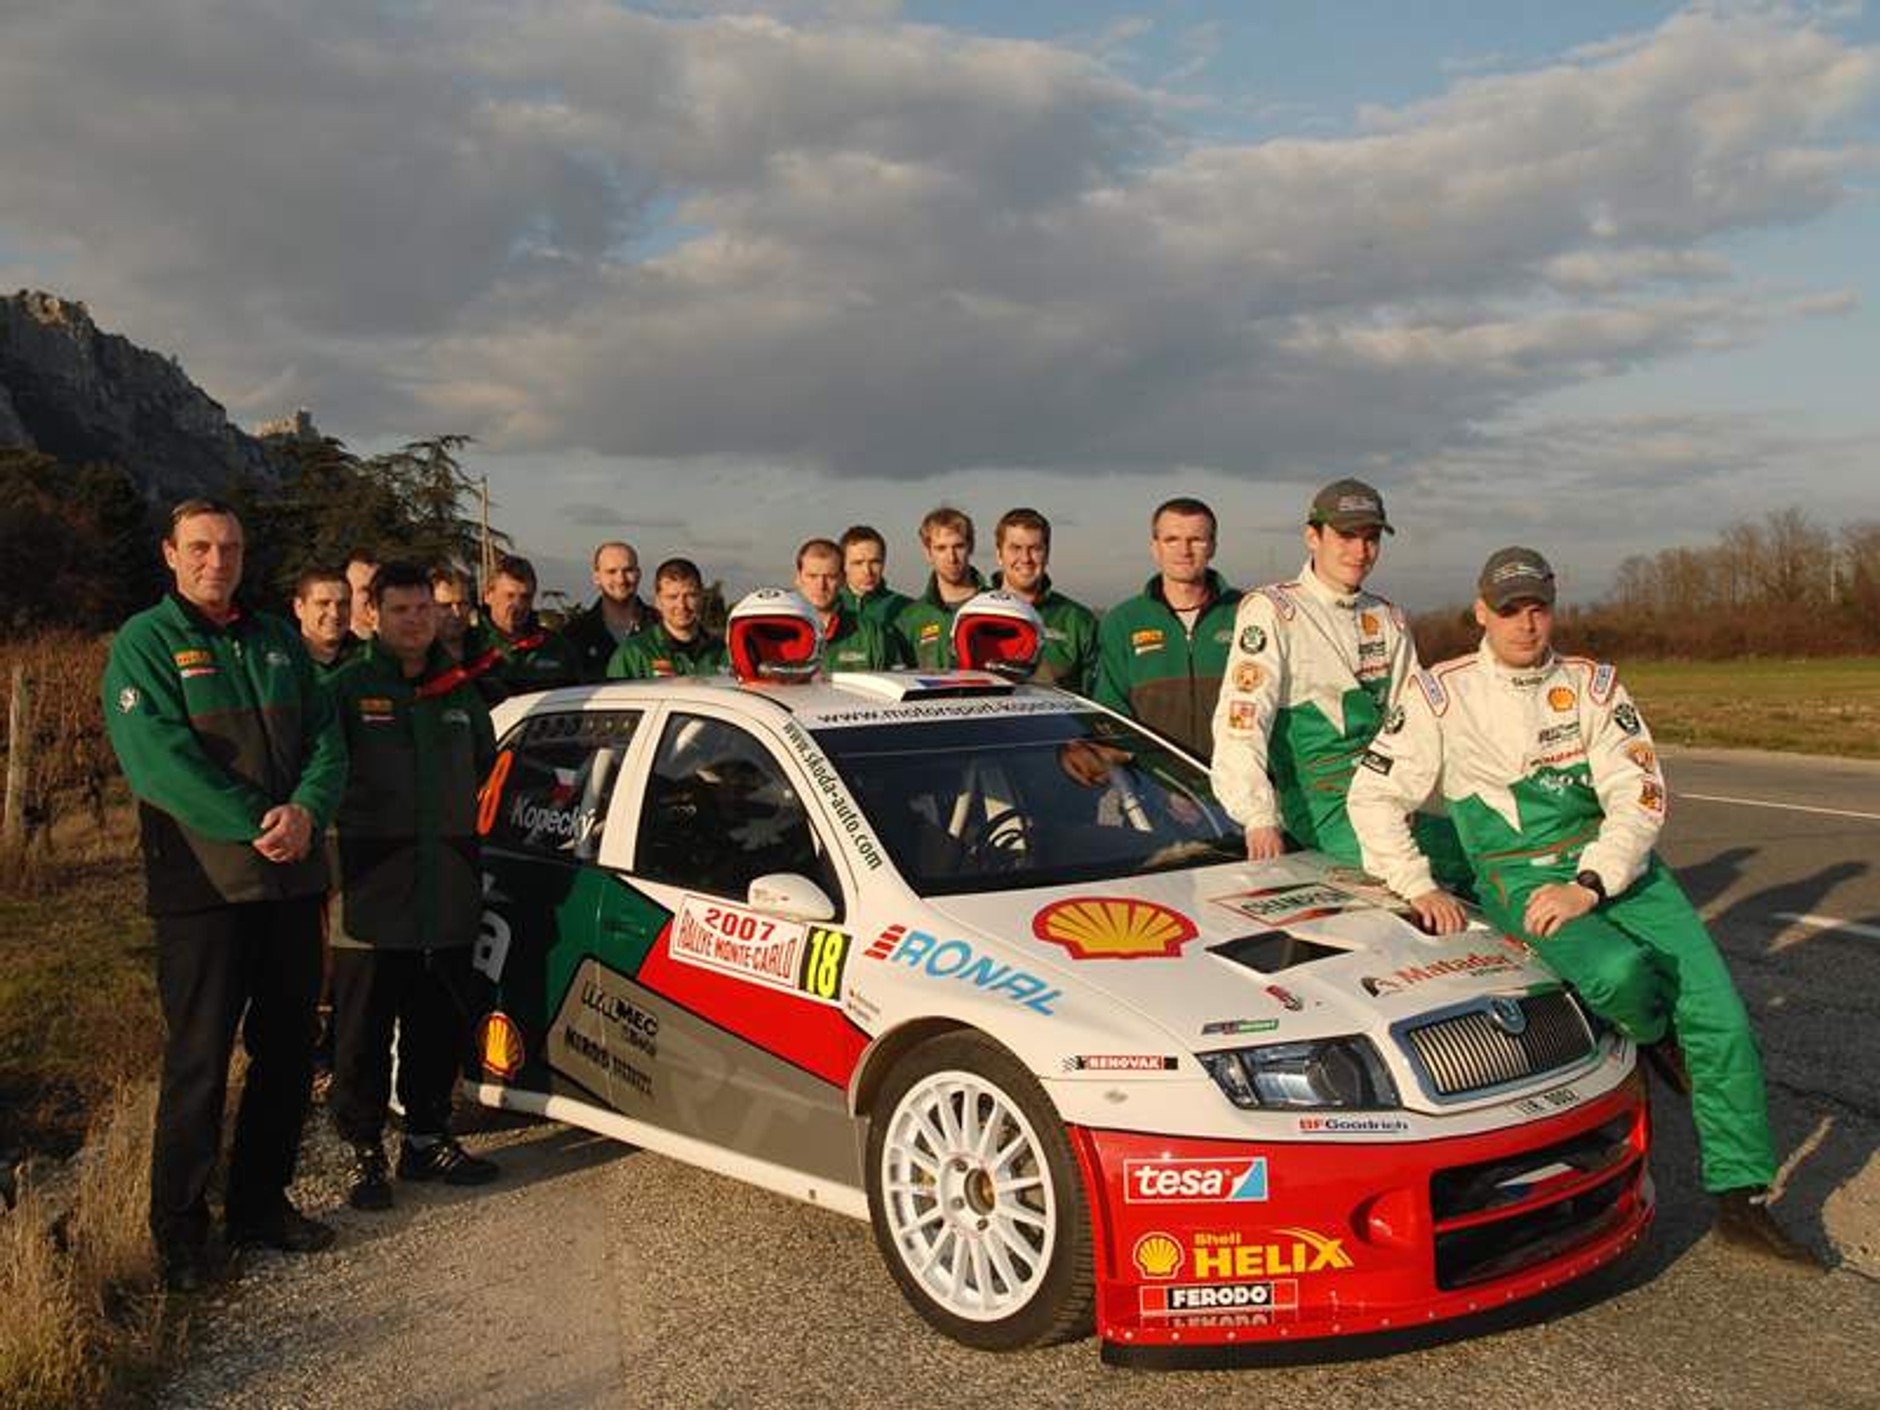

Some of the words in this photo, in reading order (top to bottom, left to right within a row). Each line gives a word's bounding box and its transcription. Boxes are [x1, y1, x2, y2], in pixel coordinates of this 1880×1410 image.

[782, 721, 882, 870] www.skoda-auto.com
[704, 907, 775, 942] 2007
[806, 930, 844, 999] 18
[892, 930, 1062, 1016] RONAL
[1299, 1117, 1409, 1131] BFGoodrich
[1134, 1165, 1224, 1196] tesa
[1194, 1231, 1242, 1246] Shell
[1194, 1238, 1352, 1279] HELIX
[1172, 1285, 1268, 1308] FERODO
